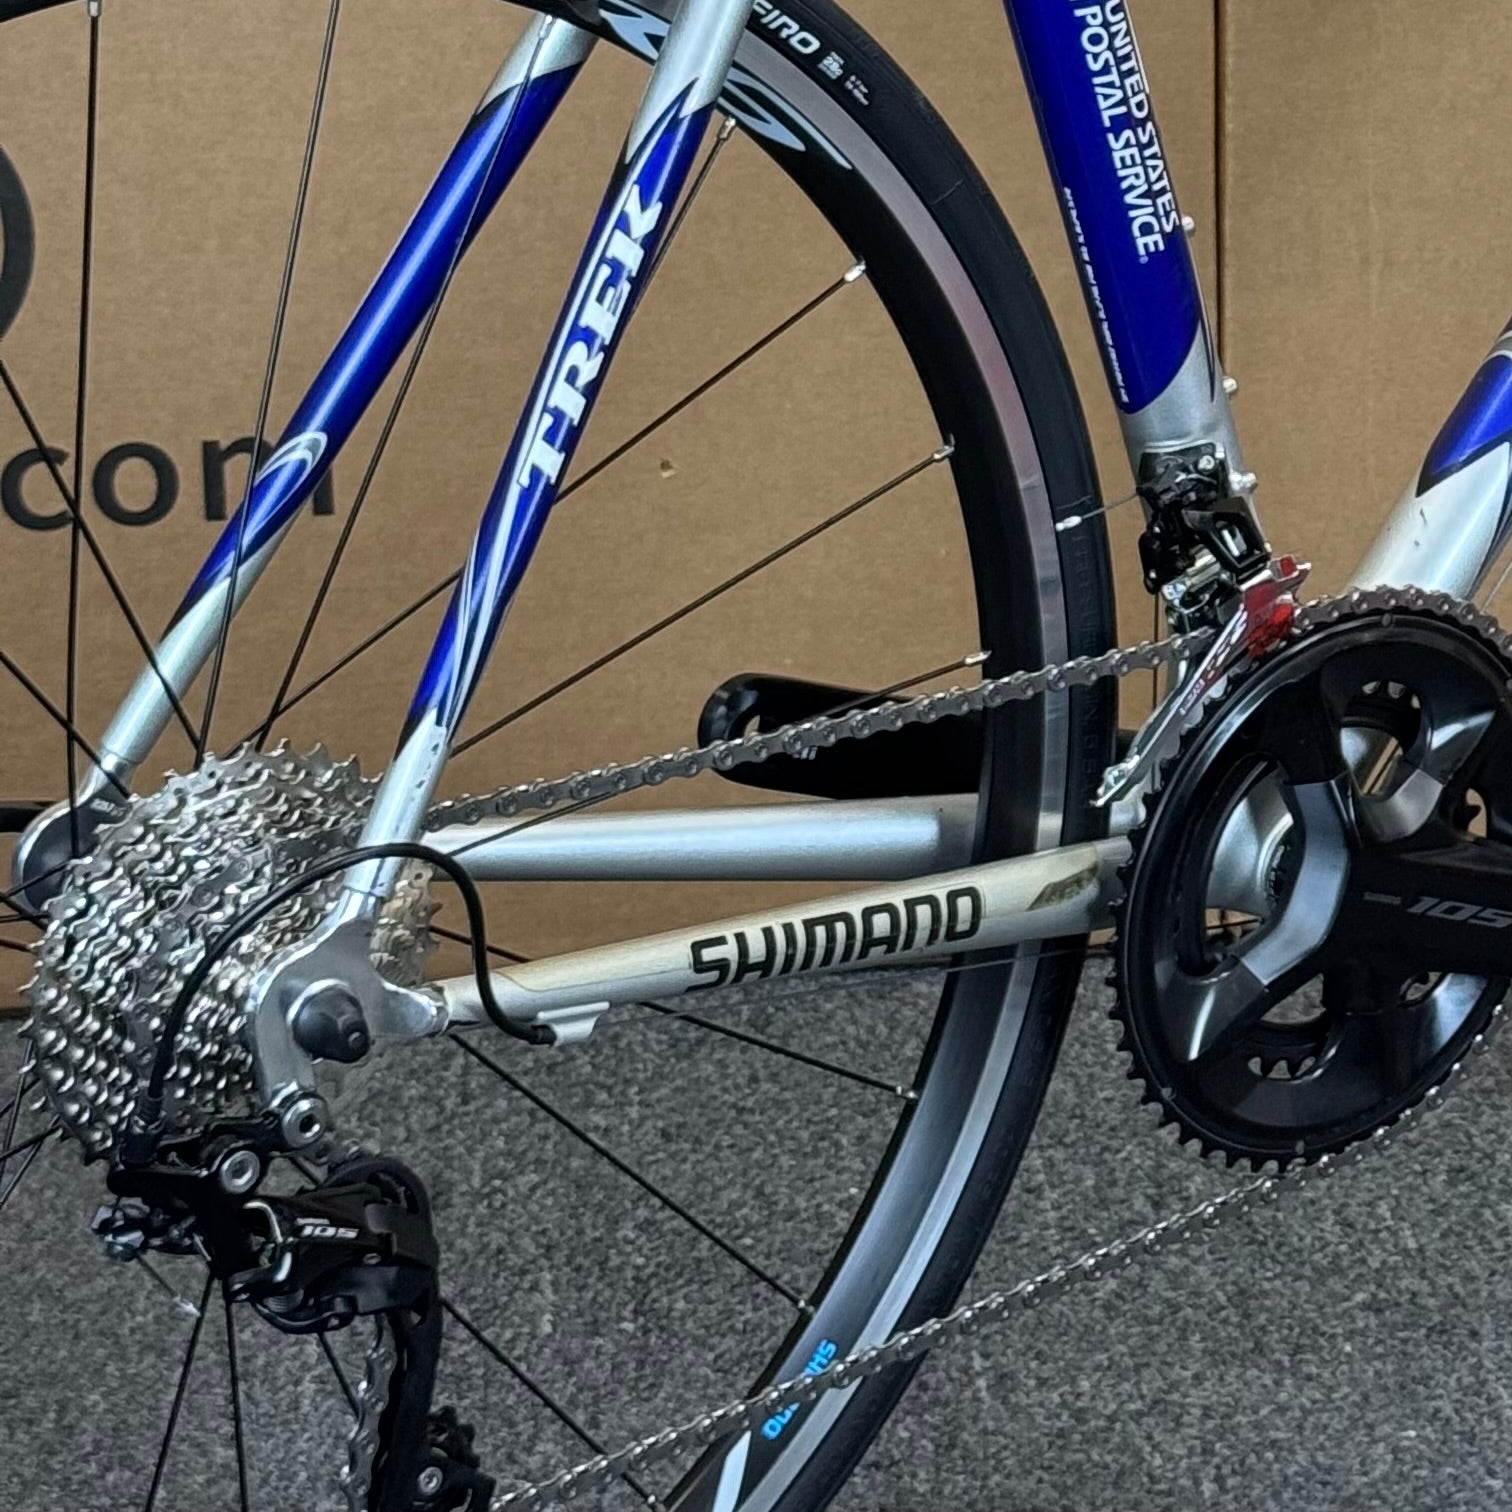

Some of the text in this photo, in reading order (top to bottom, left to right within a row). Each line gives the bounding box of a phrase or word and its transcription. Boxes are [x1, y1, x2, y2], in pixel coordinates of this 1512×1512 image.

[1074, 6, 1128, 128] POSTAL
[1107, 131, 1166, 256] SERVICE
[1137, 121, 1180, 234] STATES
[517, 184, 662, 488] TREK
[684, 886, 981, 992] SHIMANO
[300, 1225, 360, 1239] 105
